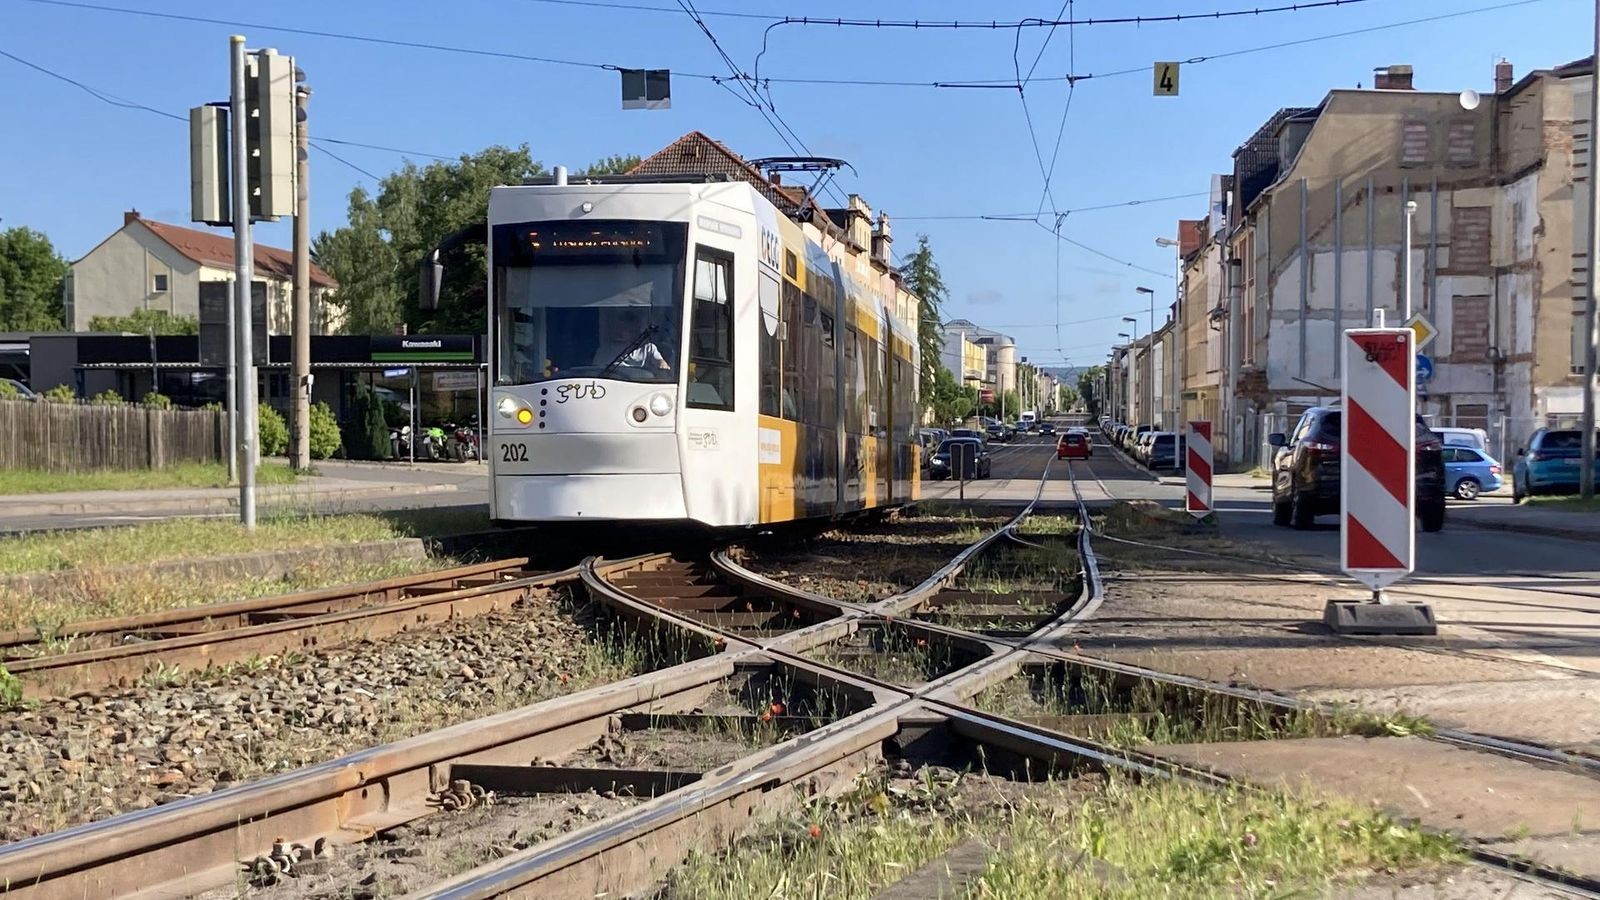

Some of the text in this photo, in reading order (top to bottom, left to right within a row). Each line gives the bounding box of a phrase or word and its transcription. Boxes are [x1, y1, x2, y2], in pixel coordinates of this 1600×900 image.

[1160, 64, 1173, 92] 4
[402, 340, 442, 348] Kawasaki
[501, 443, 529, 462] 202
